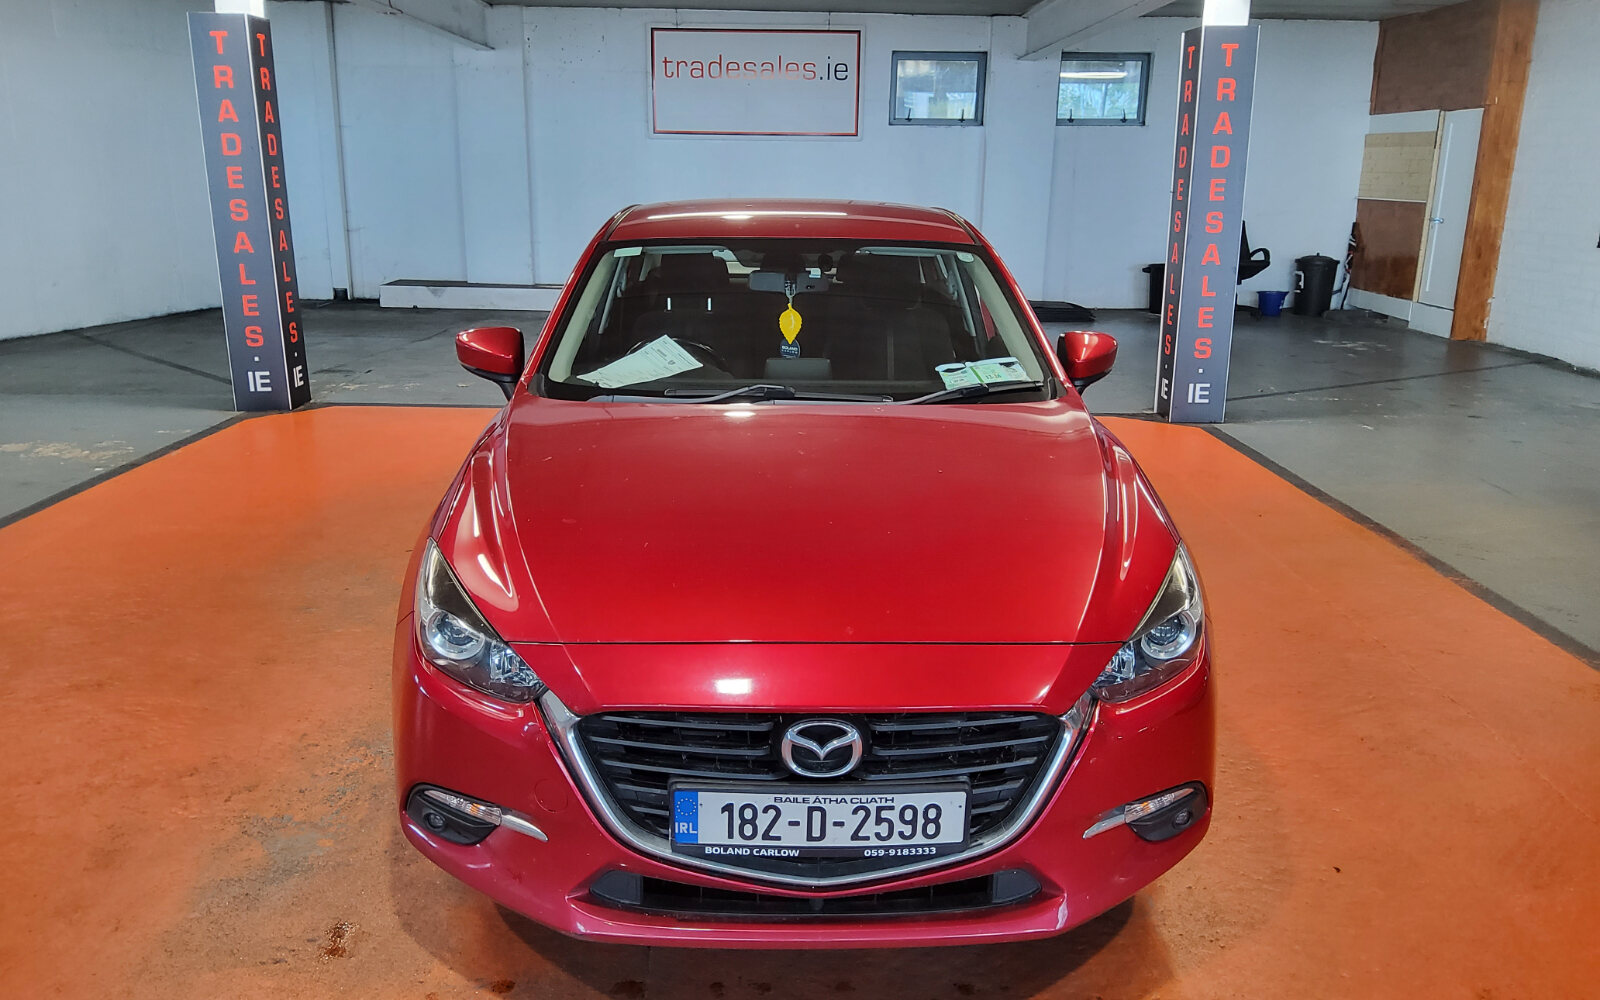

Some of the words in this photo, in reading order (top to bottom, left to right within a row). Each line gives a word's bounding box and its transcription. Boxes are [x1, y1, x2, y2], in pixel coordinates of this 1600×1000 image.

[662, 54, 849, 81] tradesales.ie
[774, 796, 810, 804] BAILE
[812, 796, 848, 805] ÁTHA
[721, 802, 943, 842] 182-D-2598
[675, 822, 698, 834] IRL
[704, 846, 750, 856] BOLAND
[753, 848, 800, 857] CARLOW
[864, 847, 937, 857] 059-9183333
